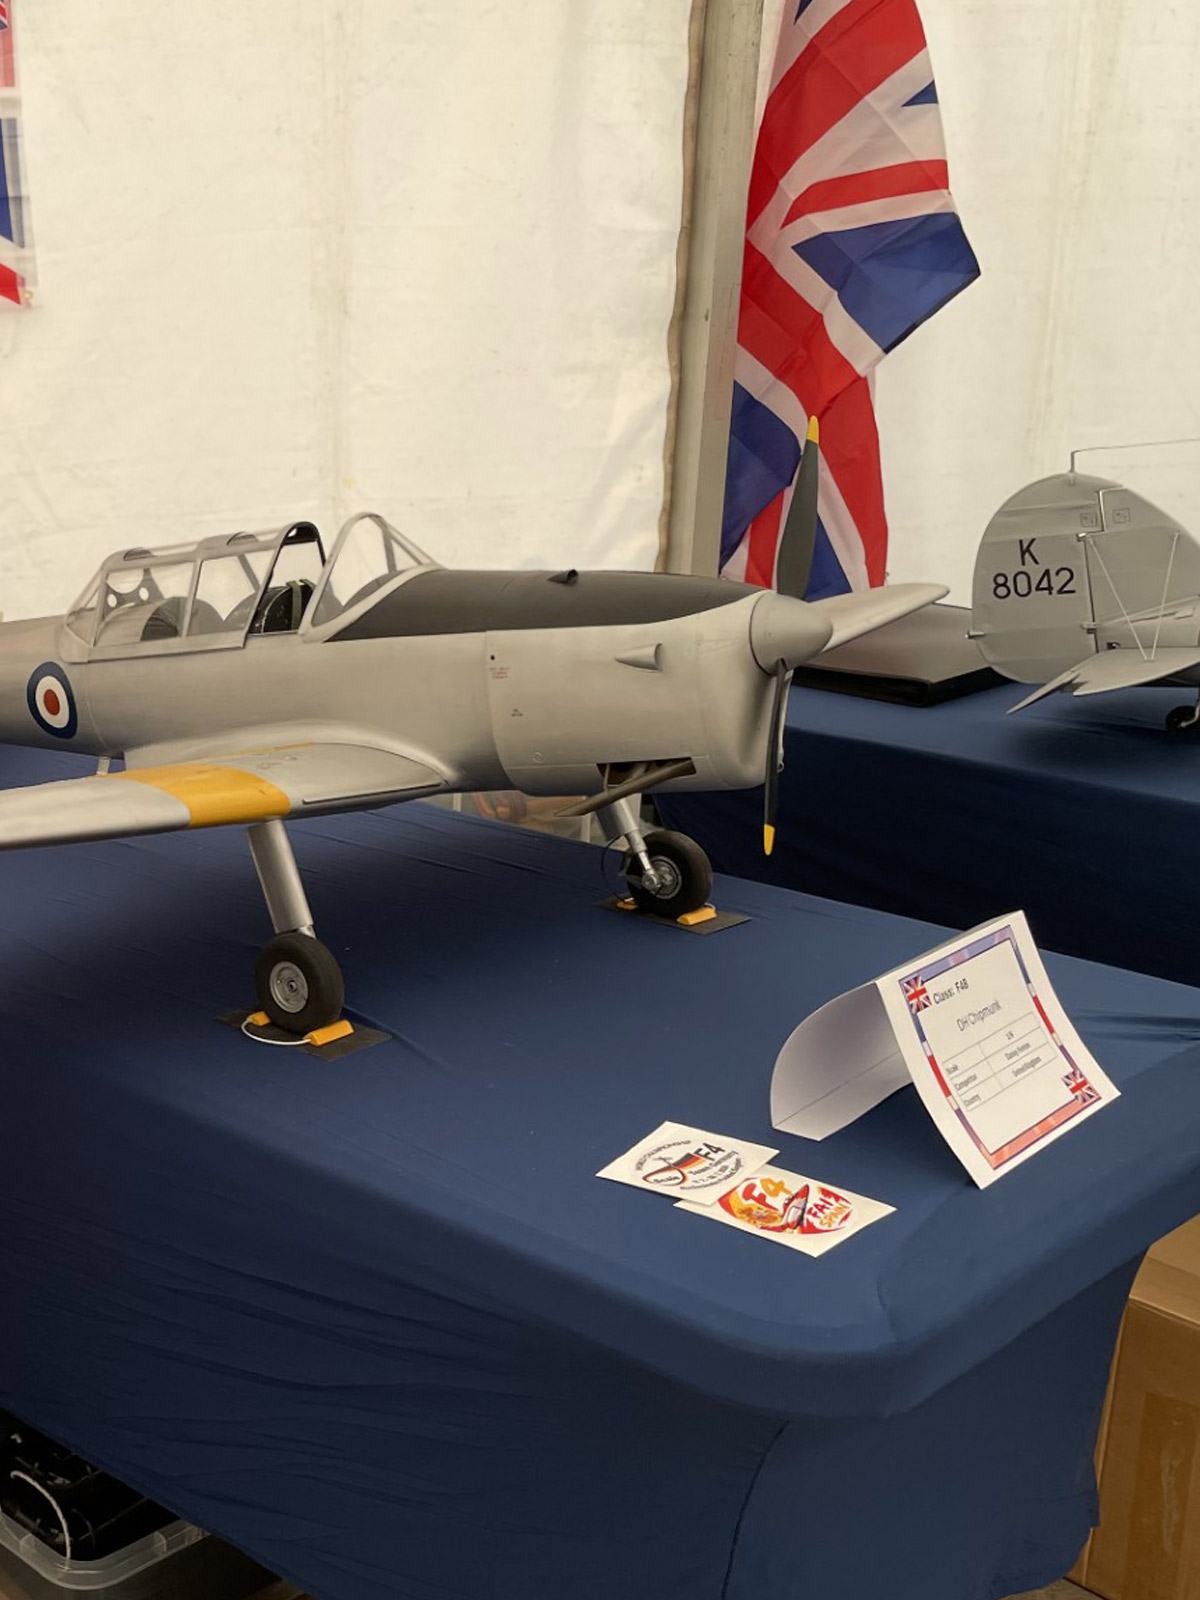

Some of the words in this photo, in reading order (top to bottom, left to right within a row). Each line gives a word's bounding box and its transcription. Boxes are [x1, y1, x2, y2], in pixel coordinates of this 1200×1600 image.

[1018, 537, 1040, 567] K
[992, 567, 1077, 600] 8042
[932, 987, 955, 1005] Class:
[968, 1000, 1001, 1024] Chipmunk
[694, 1142, 726, 1162] F4
[742, 1177, 793, 1211] F4
